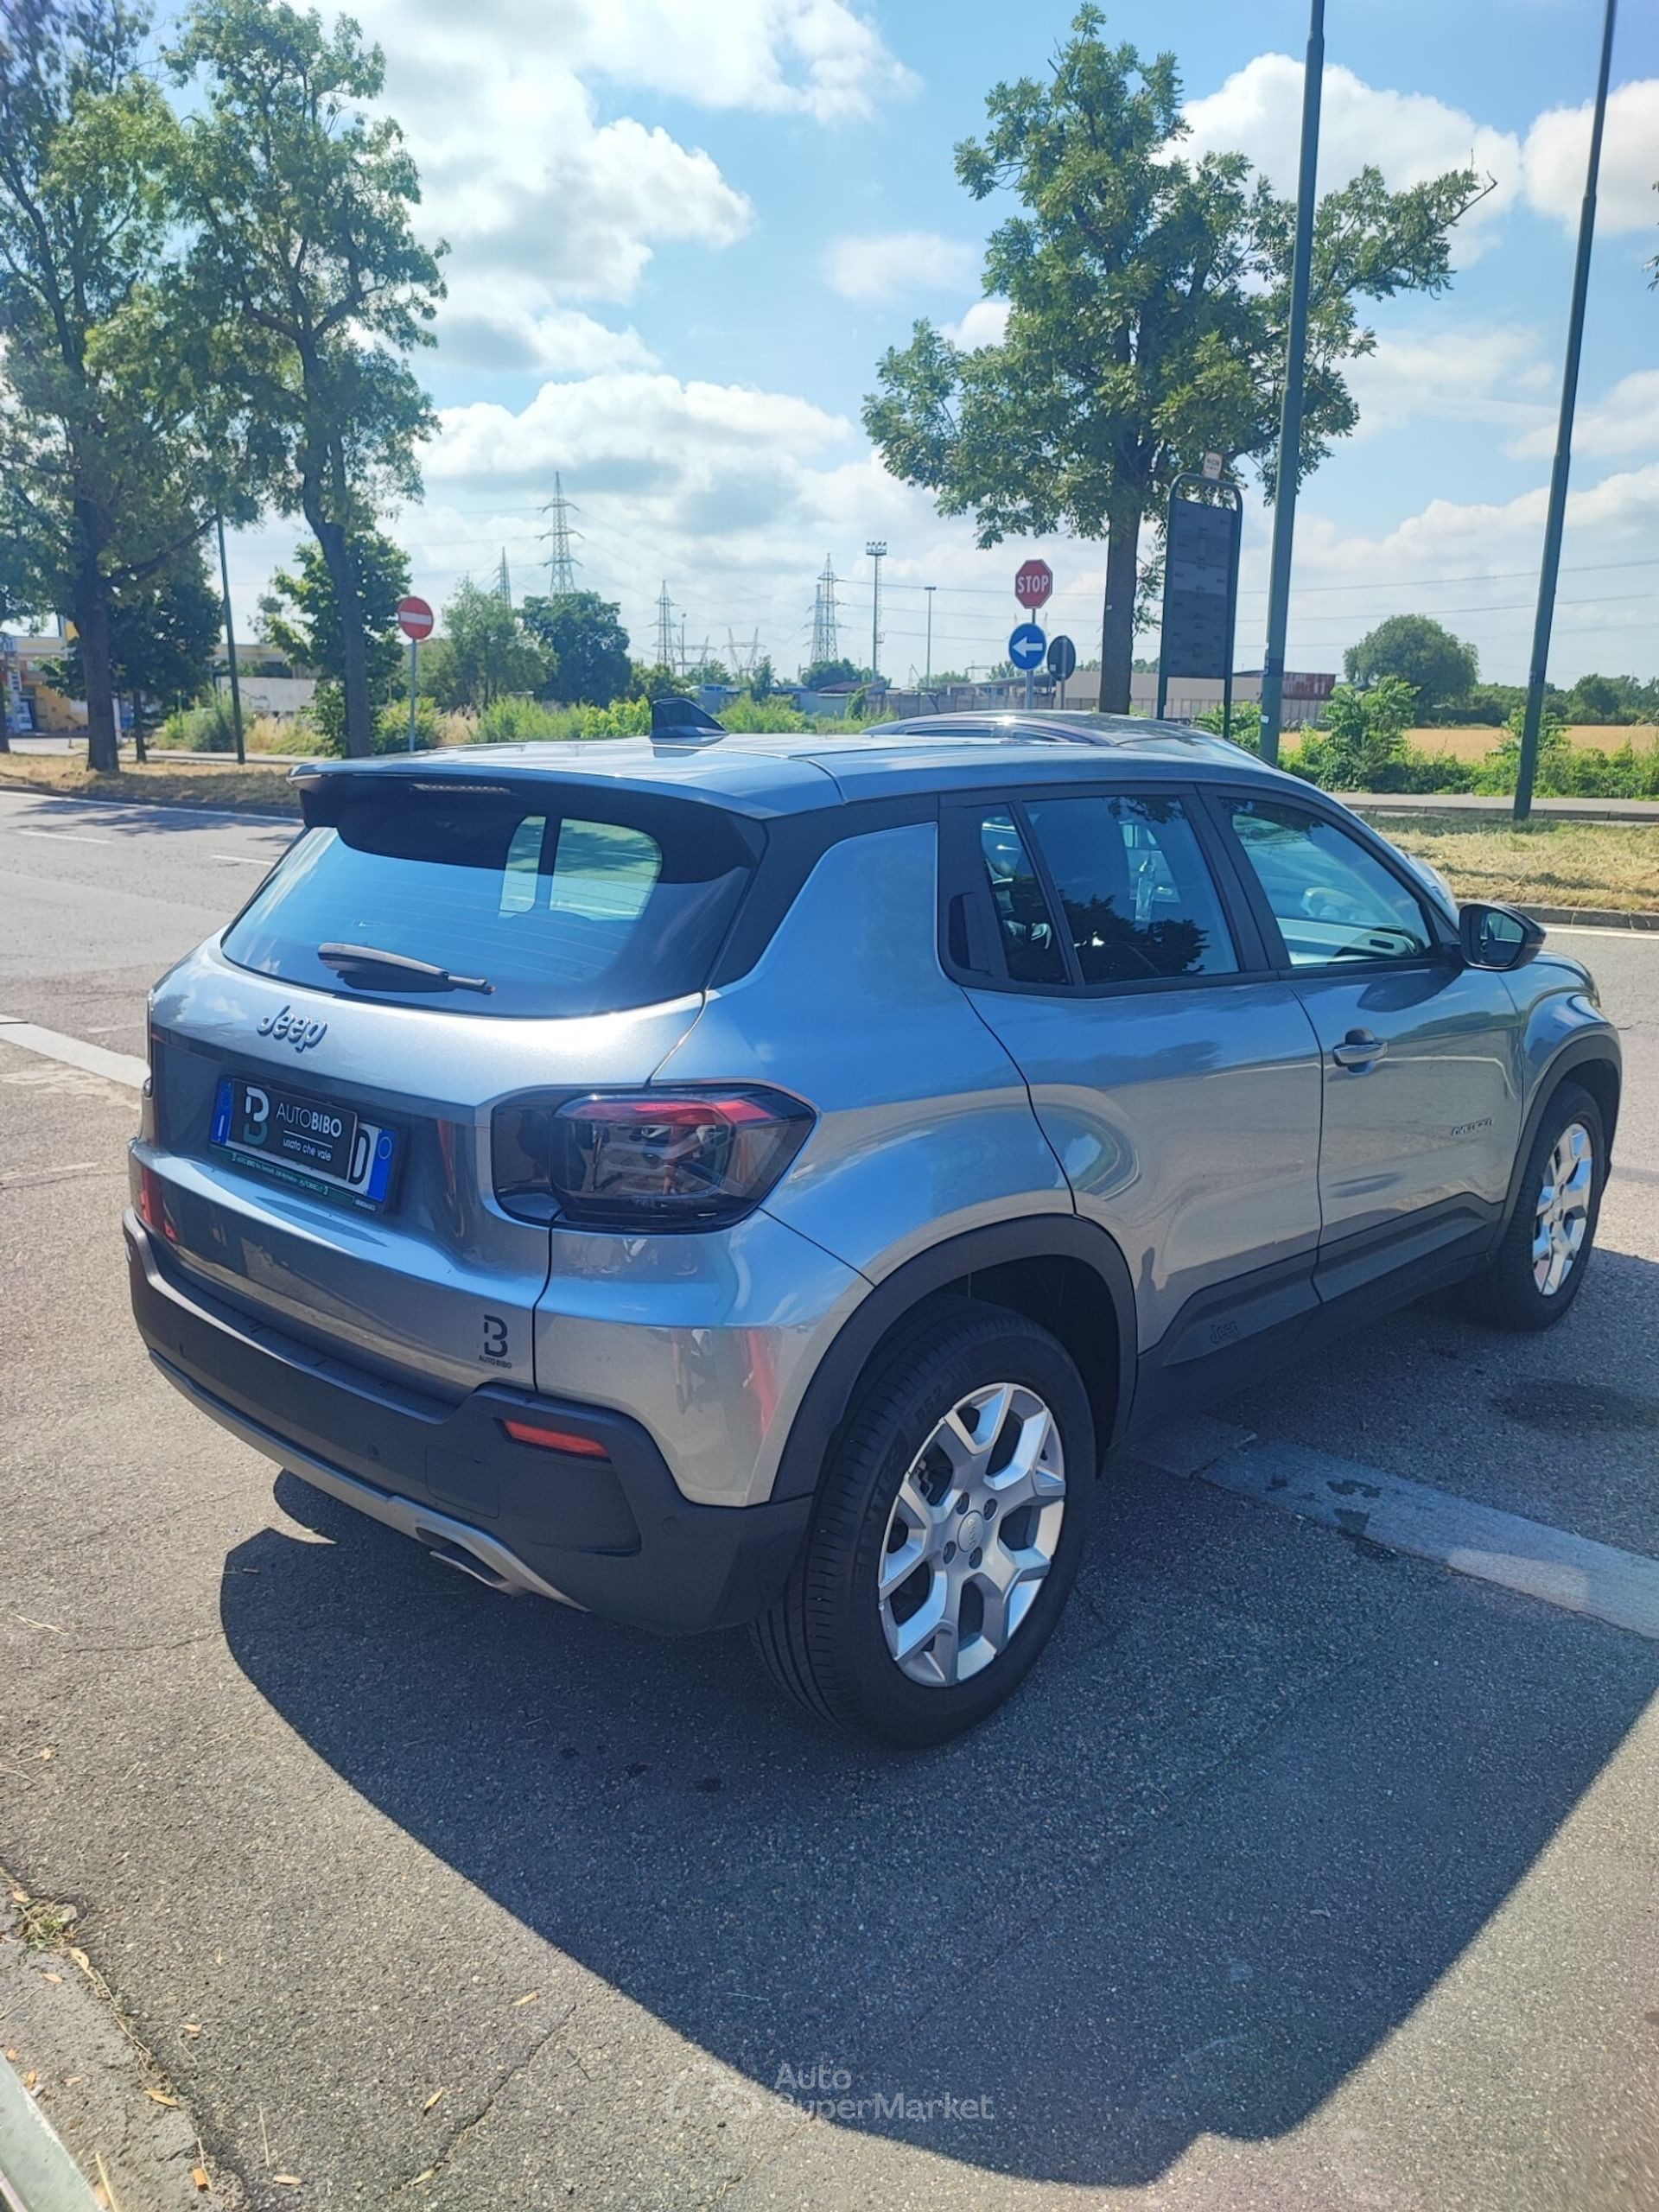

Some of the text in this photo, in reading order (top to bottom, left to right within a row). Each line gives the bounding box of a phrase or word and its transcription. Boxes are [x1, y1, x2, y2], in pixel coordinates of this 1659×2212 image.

[1017, 574, 1050, 594] STOP
[257, 1006, 328, 1053] Jeep
[276, 1103, 342, 1138] AUTOBIBO
[283, 1138, 332, 1161] usato che vale
